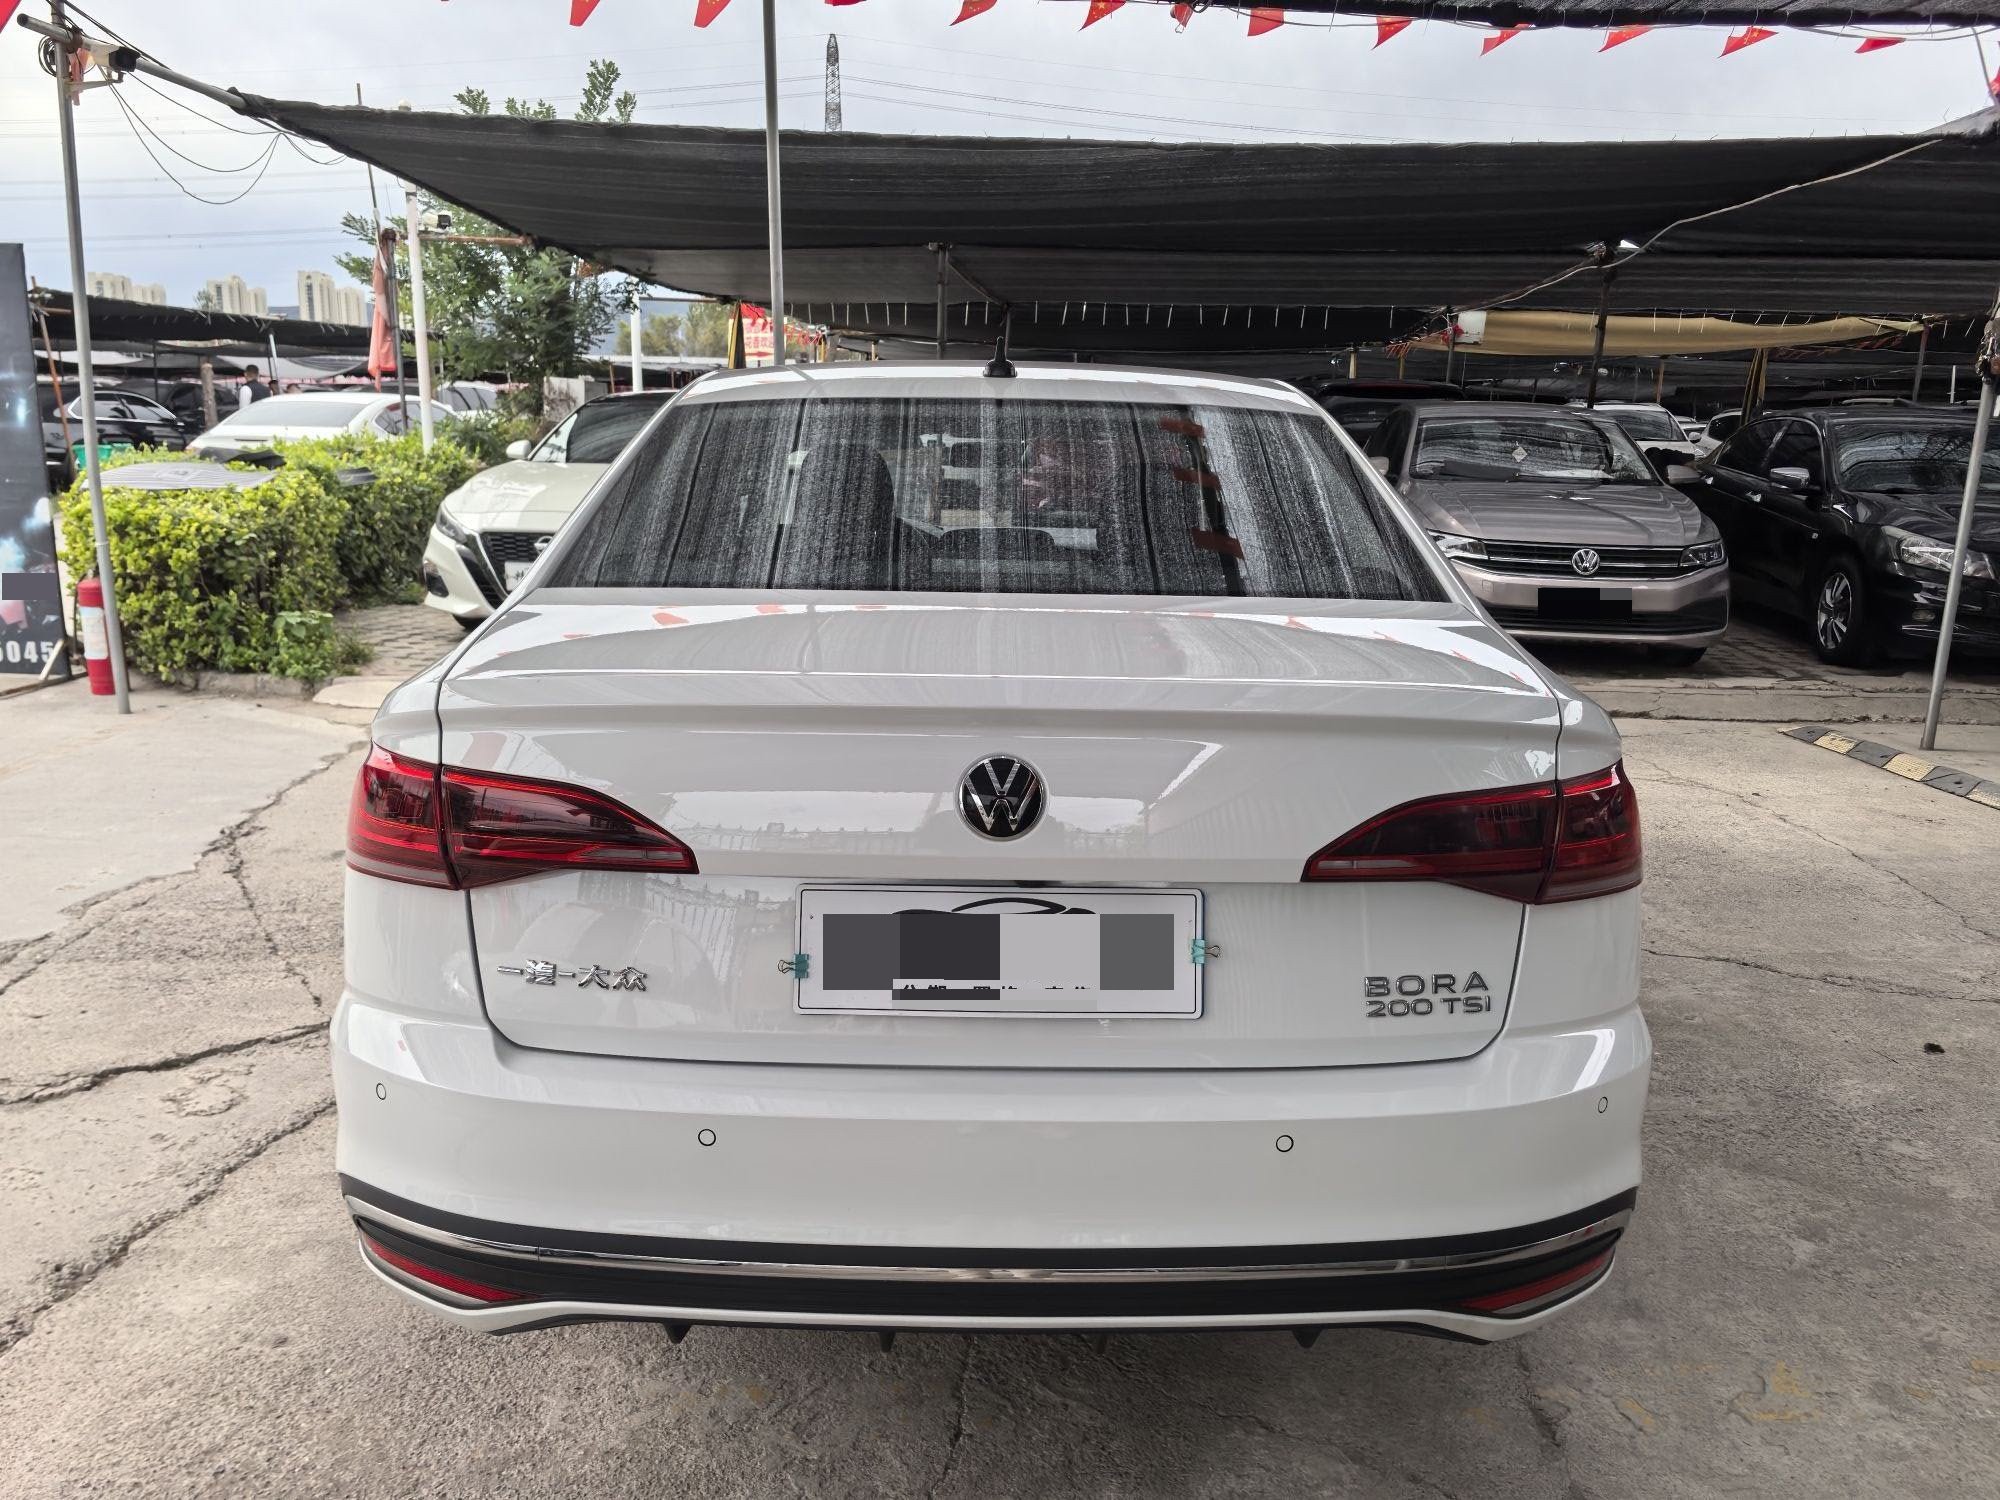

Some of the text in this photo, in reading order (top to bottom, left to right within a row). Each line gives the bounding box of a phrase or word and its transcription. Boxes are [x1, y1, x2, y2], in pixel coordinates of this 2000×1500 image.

[0, 640, 55, 664] 045
[959, 755, 1043, 838] VW
[1365, 971, 1489, 998] BORA
[1366, 995, 1491, 1018] 200 TSI
